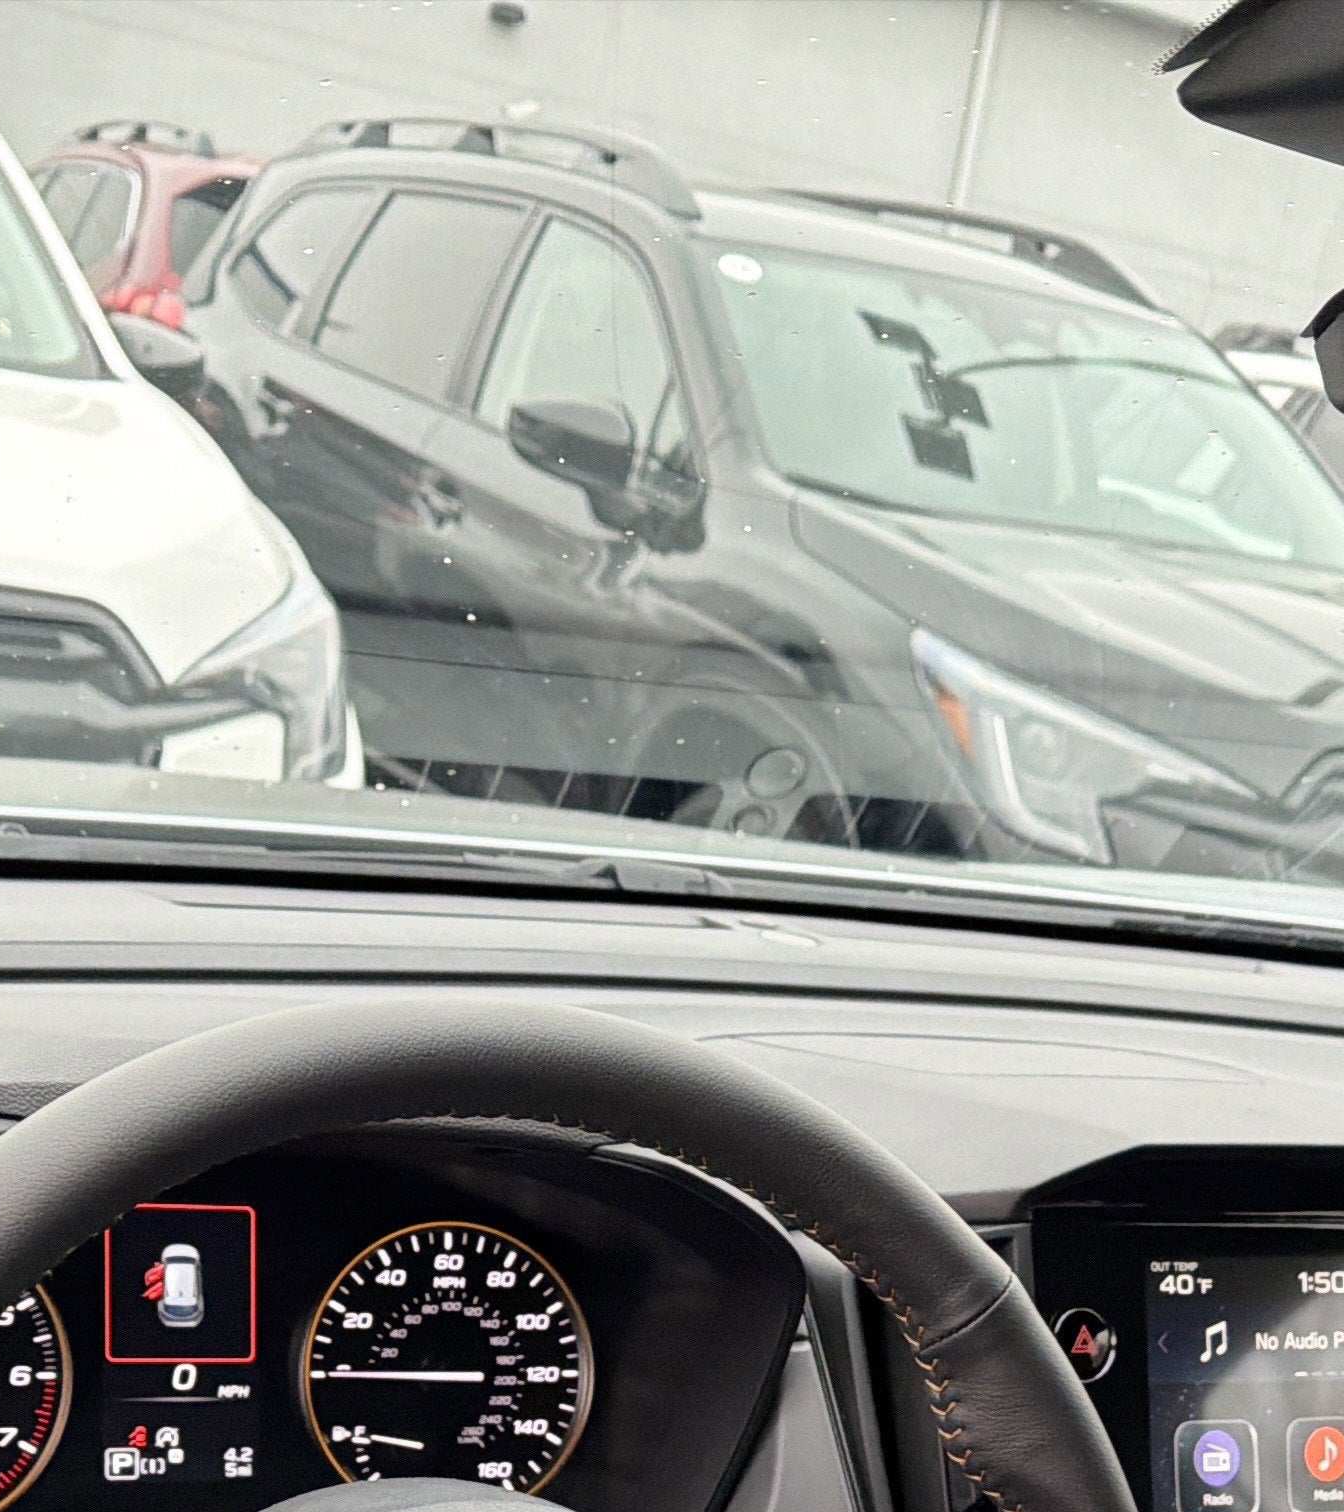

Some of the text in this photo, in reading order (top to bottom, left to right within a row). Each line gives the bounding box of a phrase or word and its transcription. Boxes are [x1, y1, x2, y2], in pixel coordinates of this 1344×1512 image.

[434, 1253, 464, 1271] 60
[375, 1269, 406, 1287] 40
[433, 1275, 466, 1289] MPH
[486, 1271, 516, 1288] 80
[1159, 1274, 1194, 1295] 40
[343, 1312, 373, 1329] 20
[515, 1314, 551, 1331] 100
[1255, 1332, 1279, 1350] No
[1284, 1332, 1328, 1350] Audio
[380, 1347, 399, 1358] 20
[9, 1365, 32, 1387] 6
[172, 1363, 197, 1391] 0
[526, 1367, 559, 1383] 120
[513, 1419, 548, 1436] 140
[478, 1462, 513, 1479] 160
[1202, 1493, 1234, 1507] Radio
